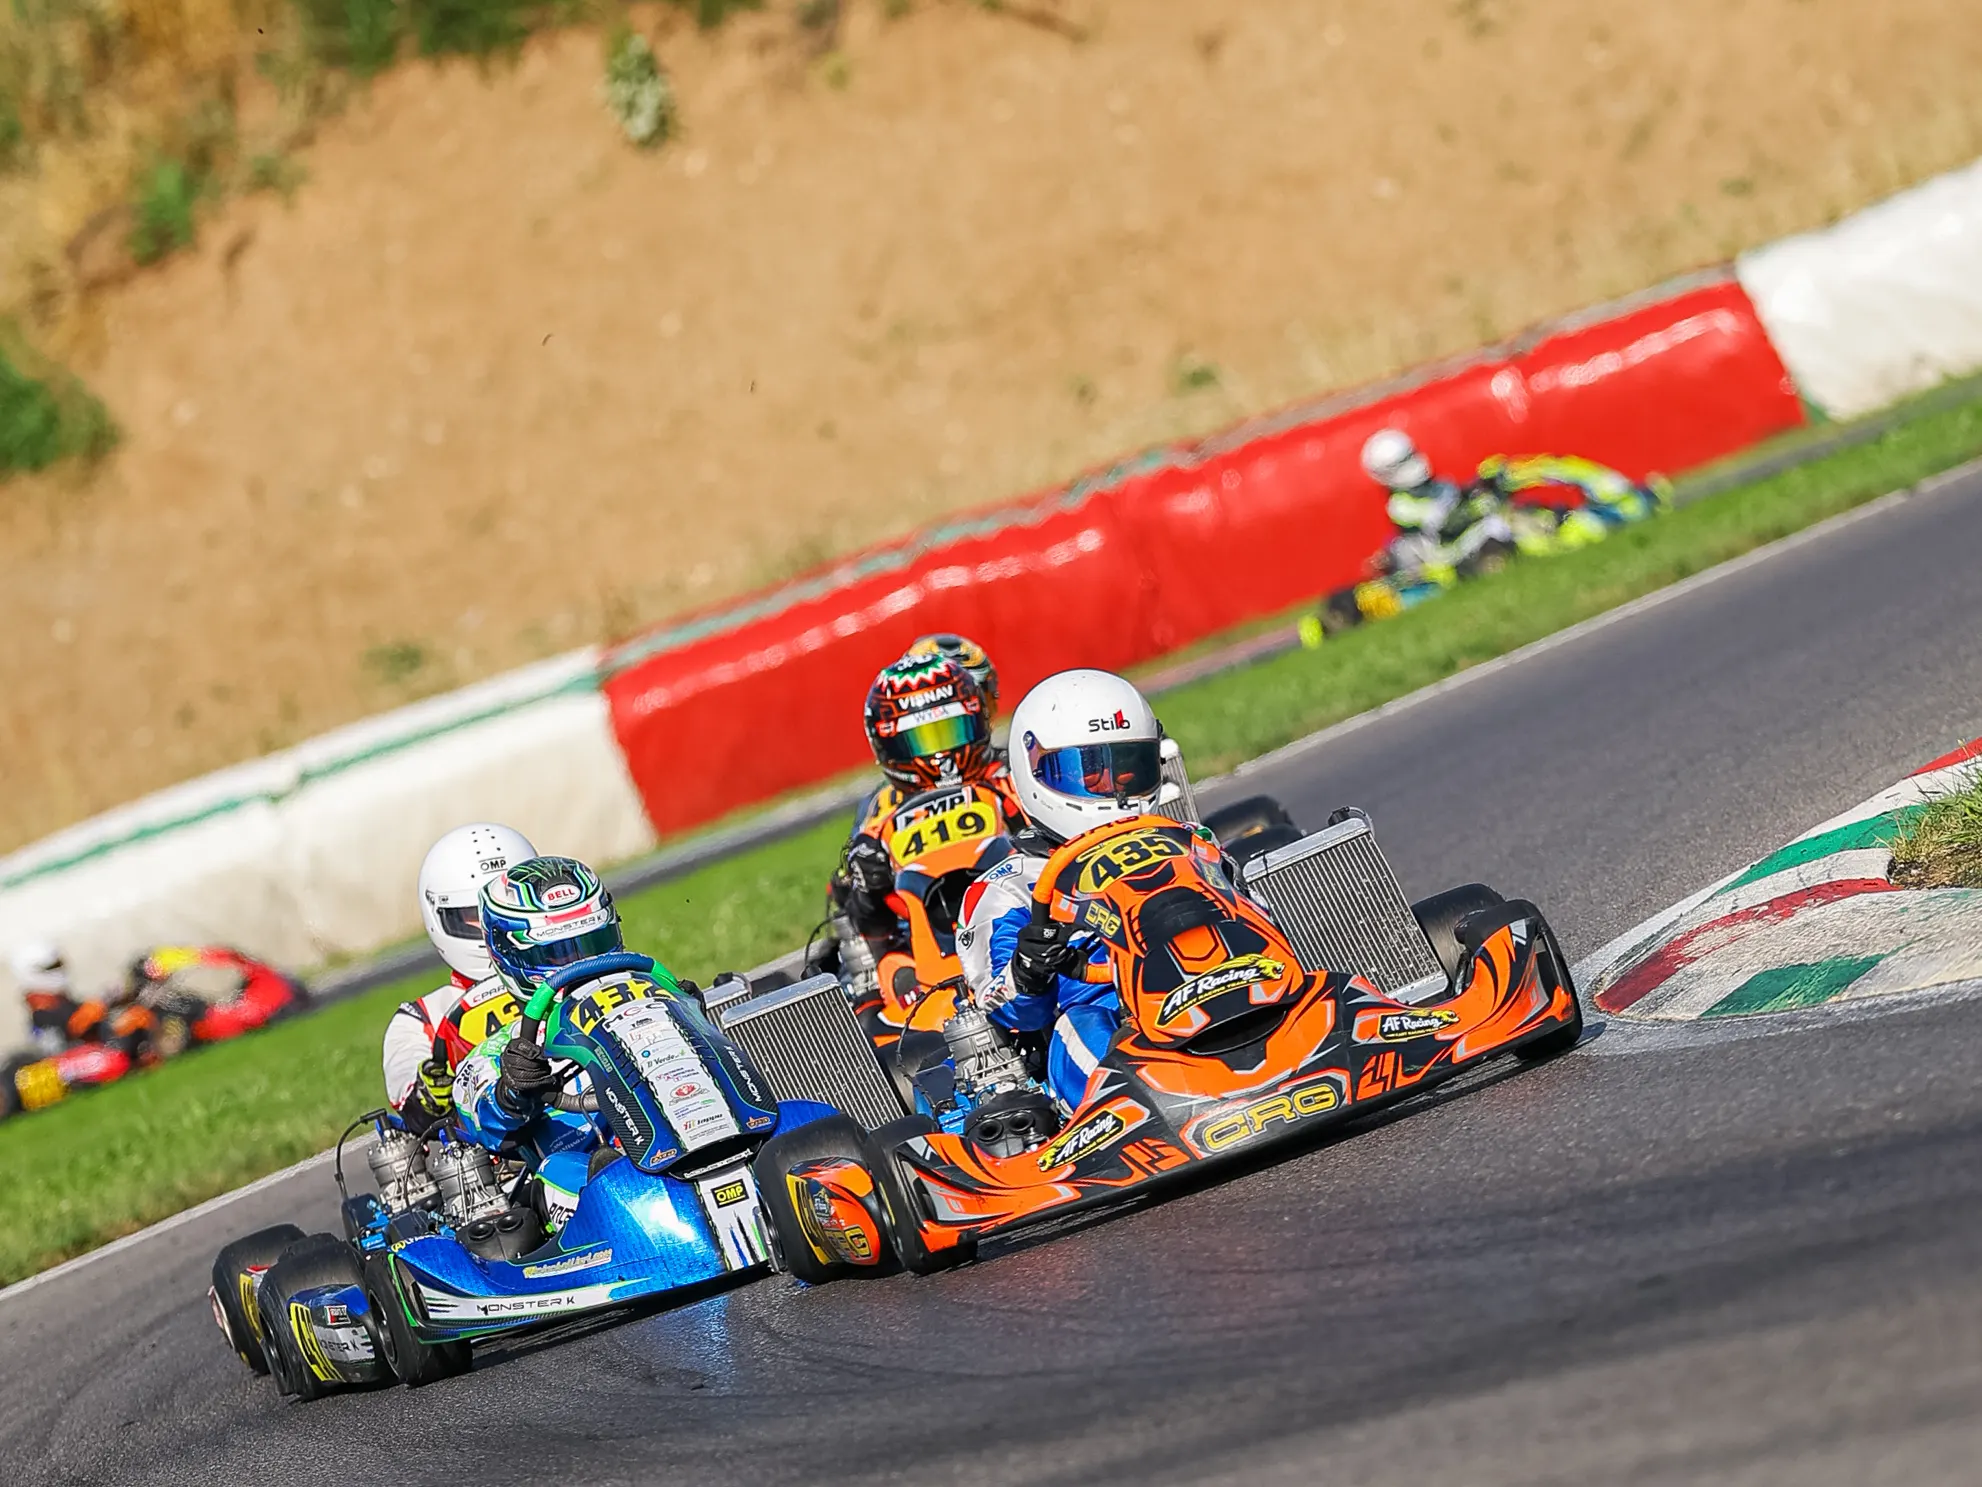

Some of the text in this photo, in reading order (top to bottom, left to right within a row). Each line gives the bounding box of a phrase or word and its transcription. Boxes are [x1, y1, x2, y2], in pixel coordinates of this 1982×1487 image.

[1088, 709, 1131, 732] Stilo
[902, 812, 986, 859] 419
[480, 860, 507, 871] OMP
[989, 863, 1014, 880] OMP
[1091, 836, 1185, 889] 435
[547, 887, 575, 902] BELL
[536, 917, 597, 937] MONSTER
[1085, 901, 1122, 939] CRG
[1163, 968, 1261, 1016] AF Racing
[1382, 1016, 1443, 1033] AF Racing
[1204, 1083, 1337, 1151] CRG
[1054, 1114, 1117, 1163] AF Racing
[716, 1185, 744, 1202] OMP
[477, 1296, 576, 1316] MONSTER K
